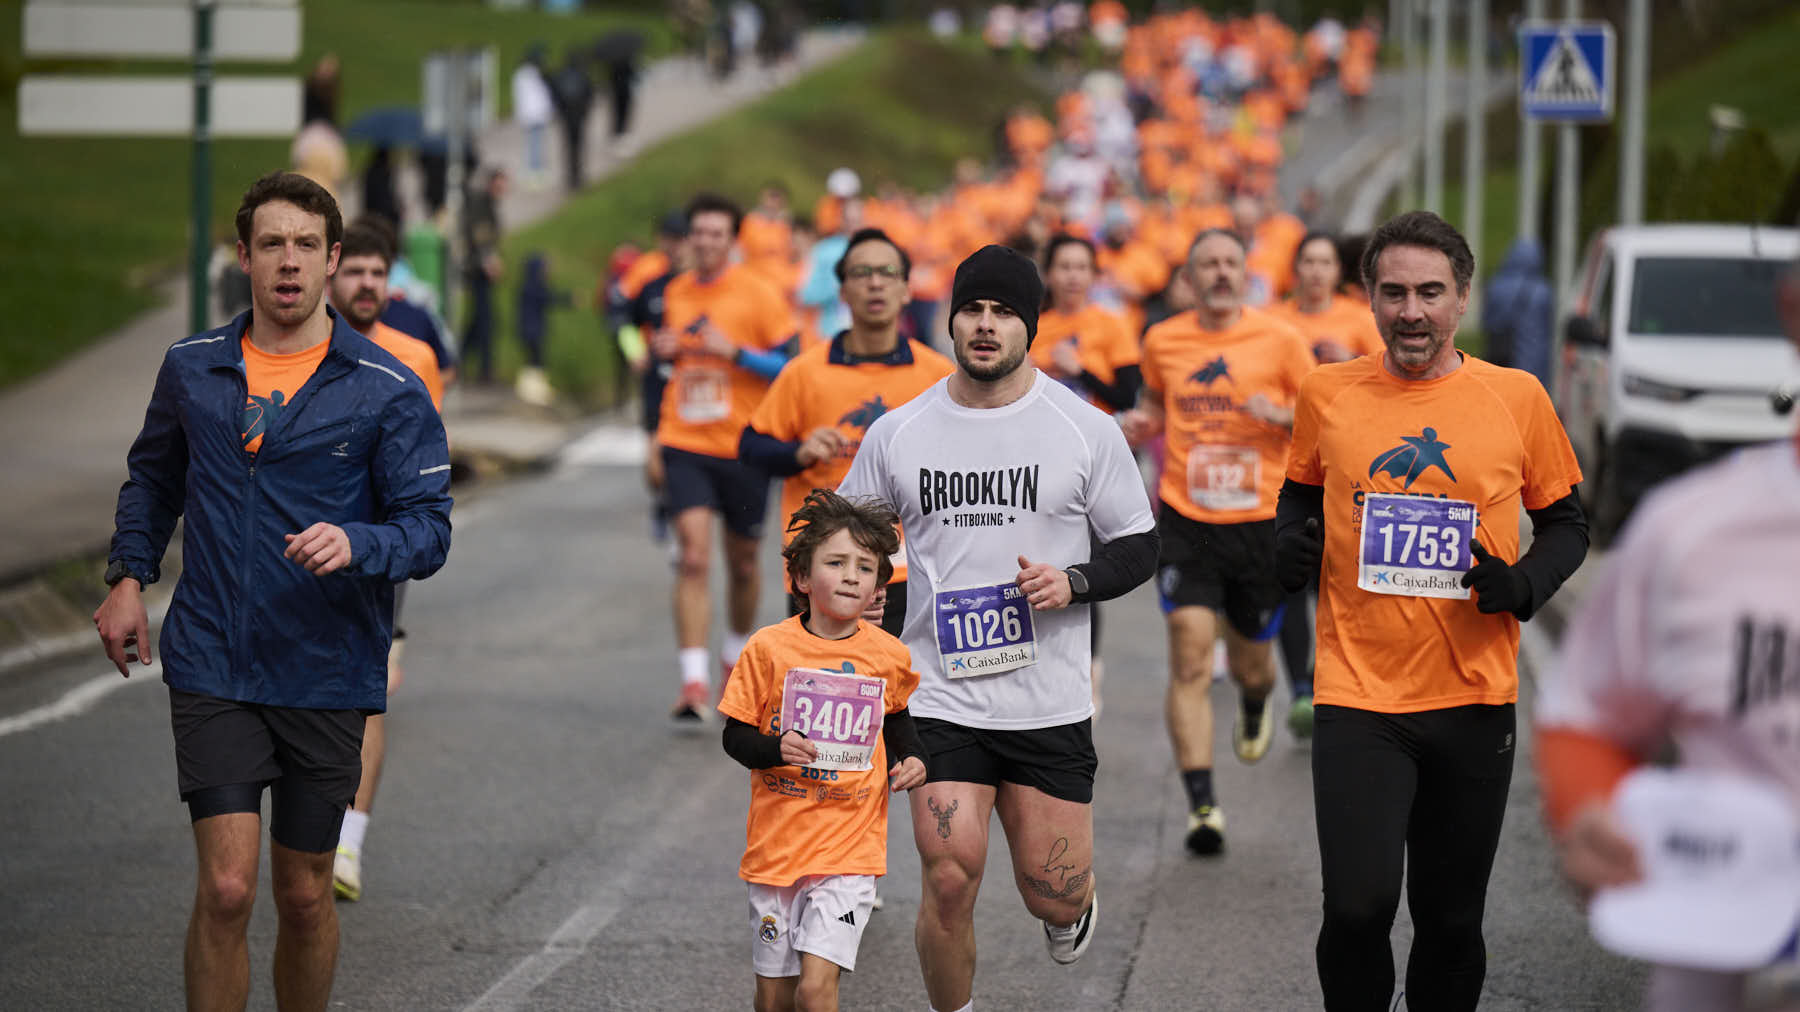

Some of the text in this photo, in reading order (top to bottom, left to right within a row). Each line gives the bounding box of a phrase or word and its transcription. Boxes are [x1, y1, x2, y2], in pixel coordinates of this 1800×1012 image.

[920, 464, 1039, 516] BROOKLYN
[954, 512, 1004, 528] FITBOXING
[1447, 507, 1471, 521] 5KM
[1379, 522, 1461, 568] 1753
[1392, 572, 1459, 591] CaixaBank
[948, 606, 1022, 649] 1026
[967, 648, 1028, 669] CaixaBank
[860, 683, 881, 697] 800M
[793, 697, 873, 743] 3404
[815, 750, 864, 766] aixaBank
[800, 767, 839, 781] 2026
